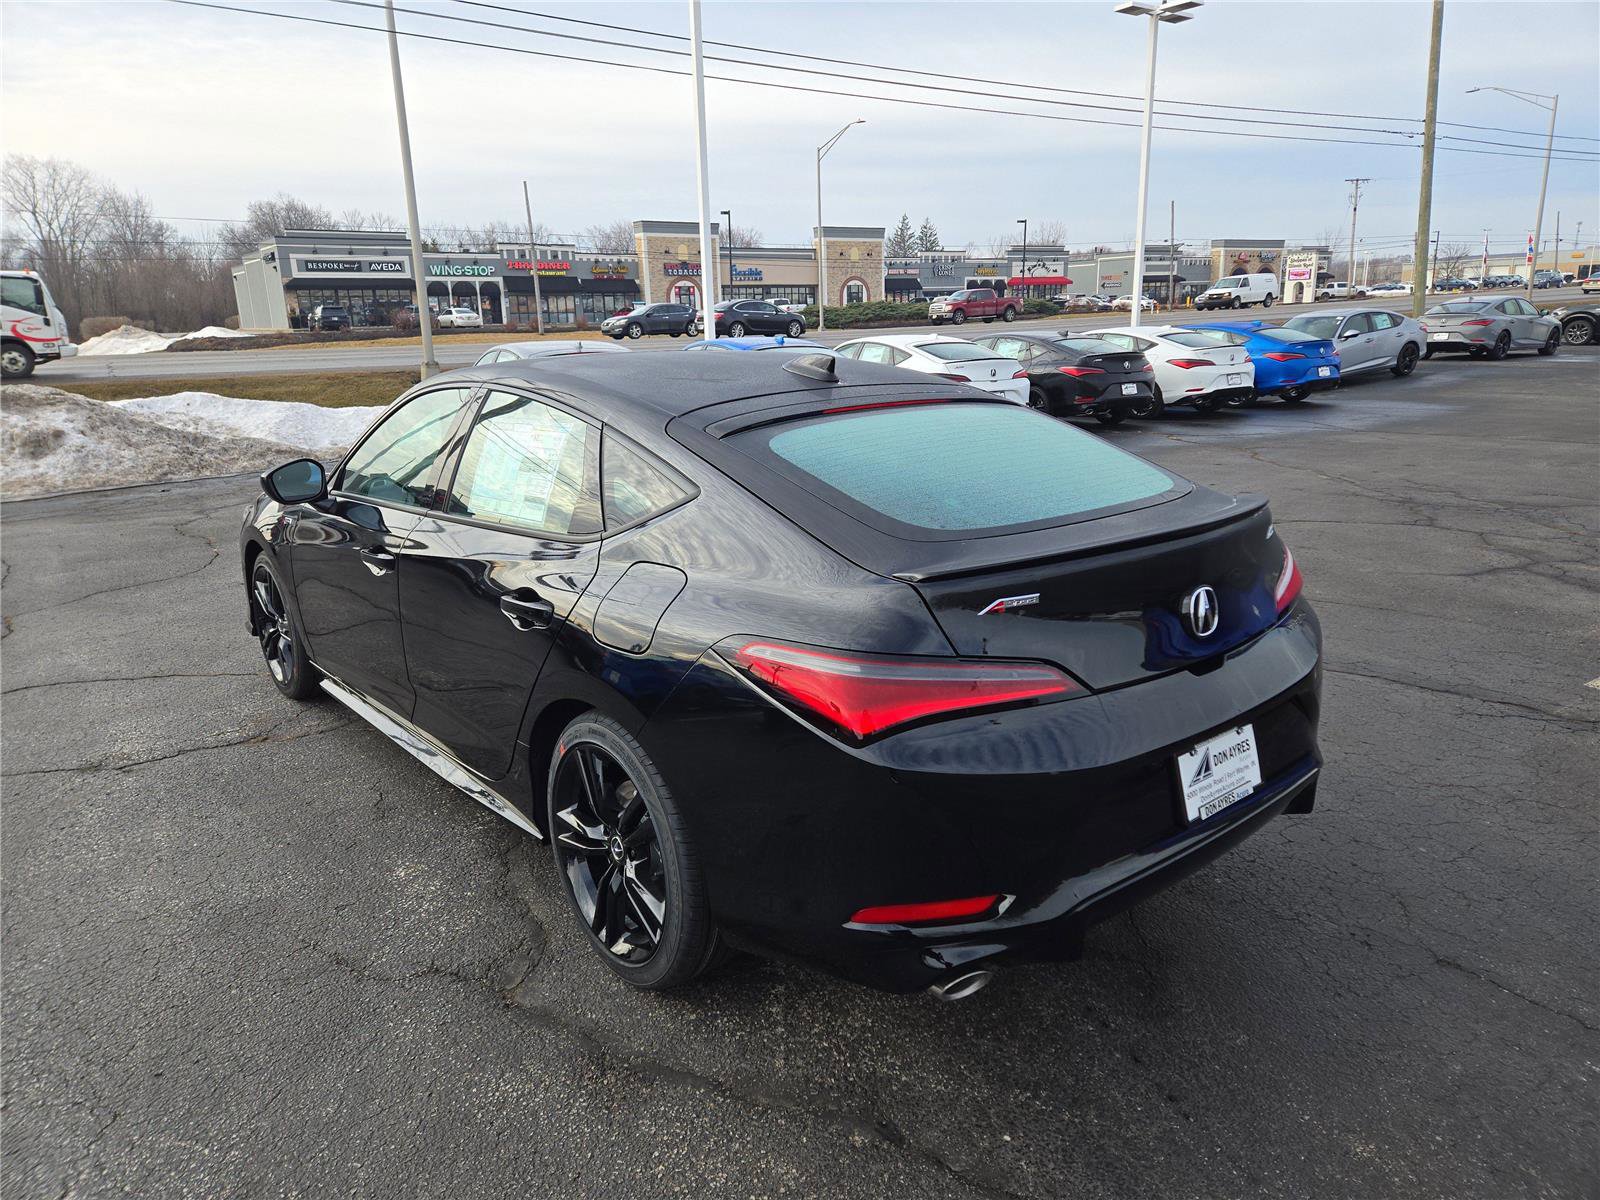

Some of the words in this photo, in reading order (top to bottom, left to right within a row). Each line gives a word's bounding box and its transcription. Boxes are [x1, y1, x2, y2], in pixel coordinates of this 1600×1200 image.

[370, 263, 402, 271] AVEDA
[1213, 750, 1229, 767] DON
[1228, 739, 1251, 759] AYRES
[1205, 803, 1218, 817] DON
[1217, 791, 1236, 810] AYRES
